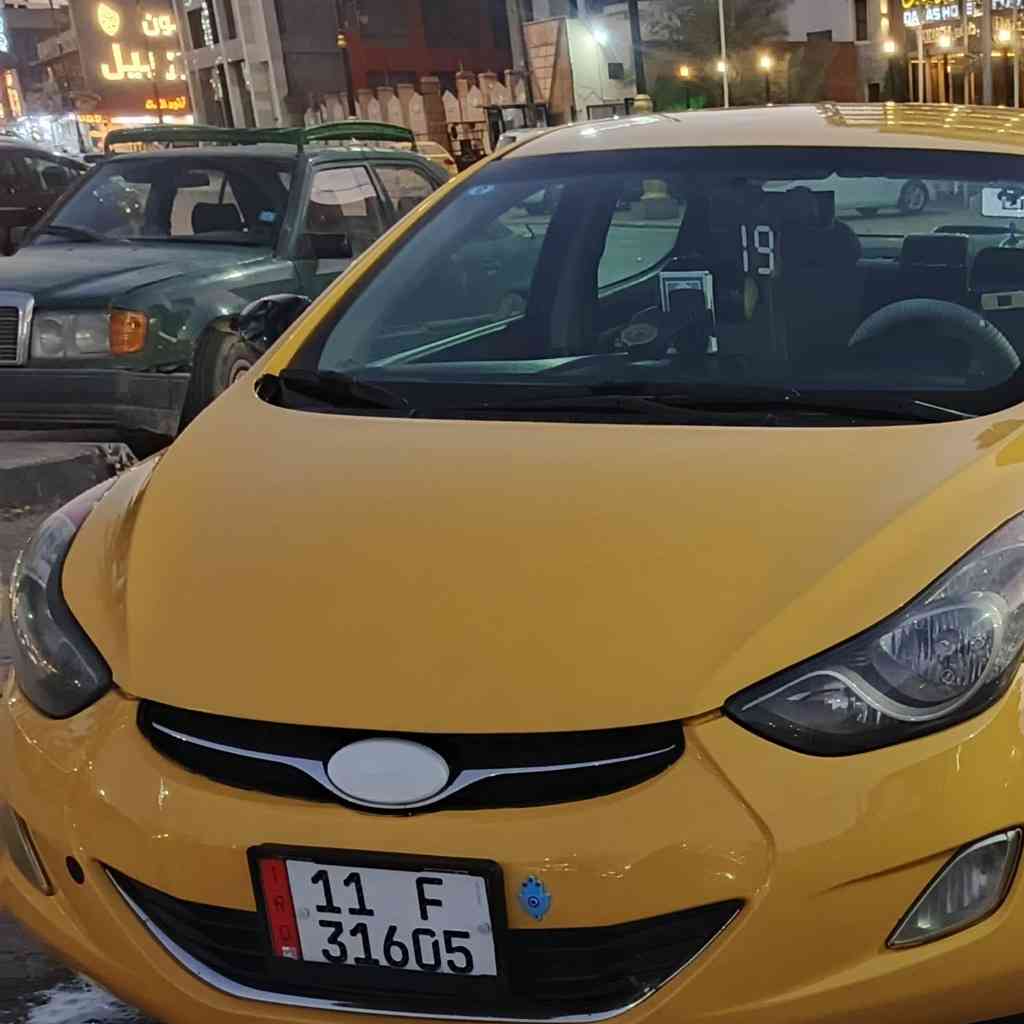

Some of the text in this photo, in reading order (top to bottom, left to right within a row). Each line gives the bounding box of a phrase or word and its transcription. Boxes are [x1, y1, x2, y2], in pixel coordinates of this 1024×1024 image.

[741, 225, 775, 275] 19
[311, 869, 444, 921] 11 F
[318, 919, 474, 974] 31605
